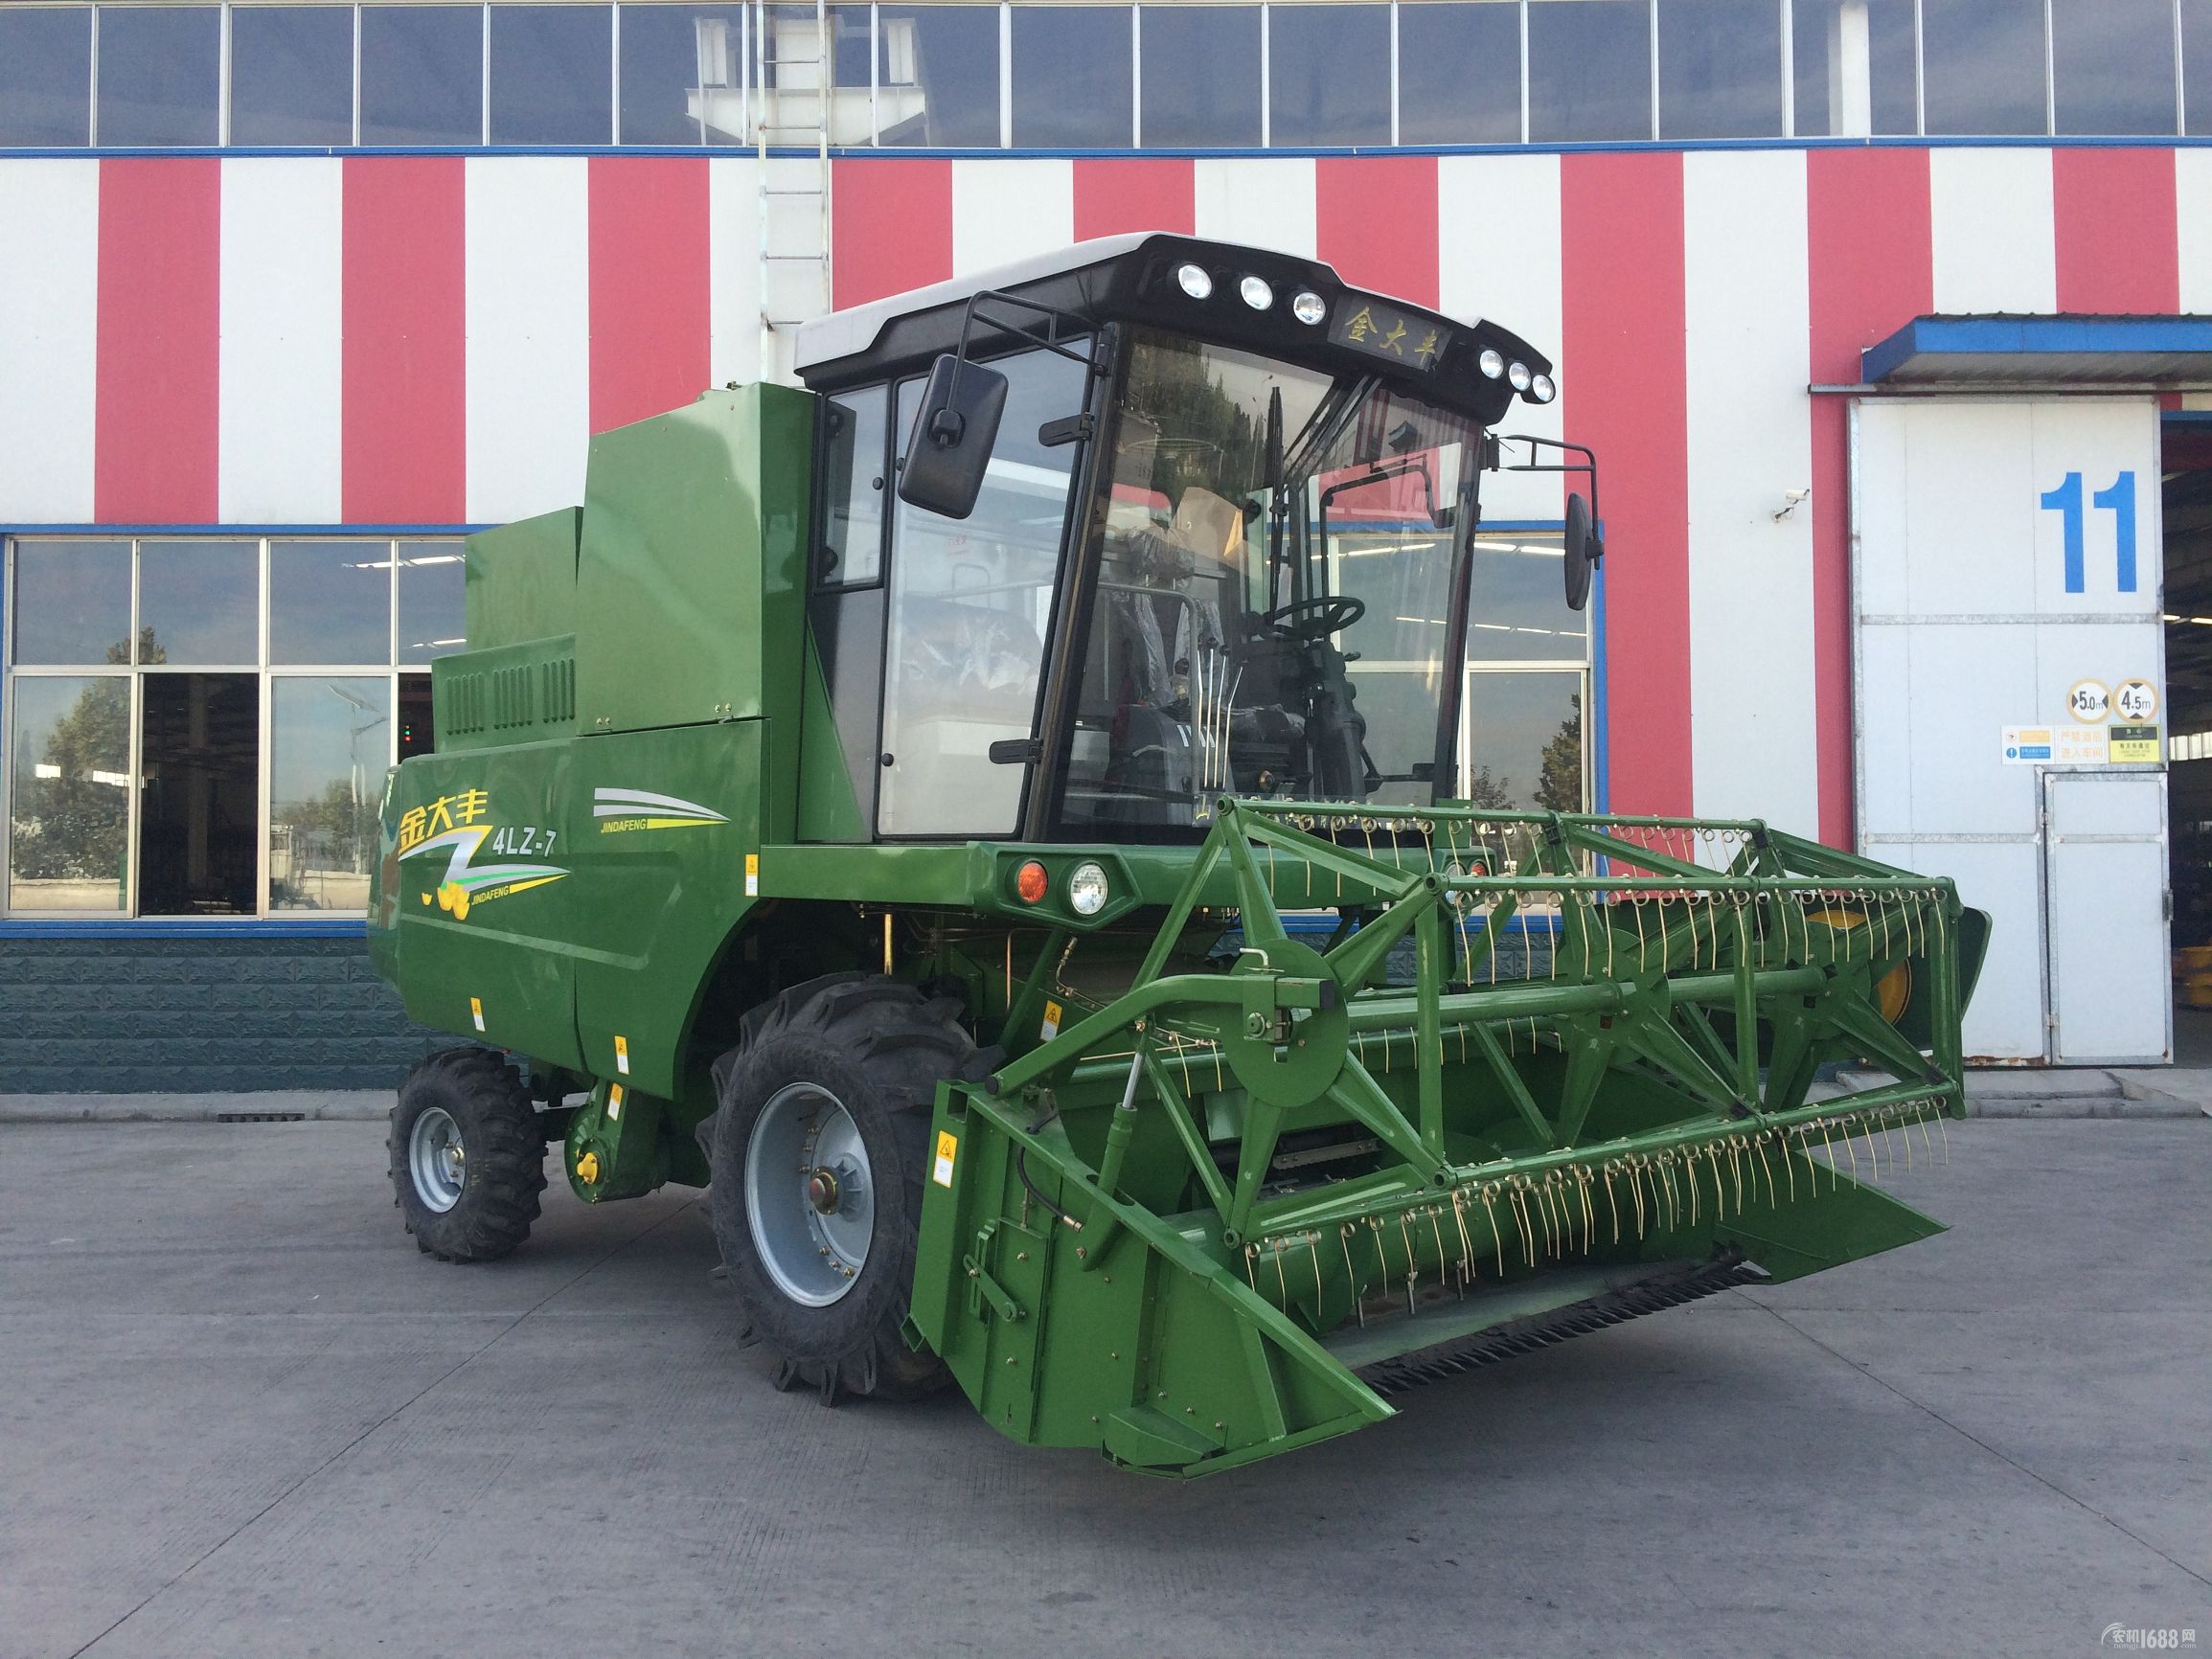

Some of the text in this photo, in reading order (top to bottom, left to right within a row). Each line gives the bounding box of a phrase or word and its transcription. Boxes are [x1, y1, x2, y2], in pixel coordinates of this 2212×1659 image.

[2041, 470, 2137, 594] 11
[2121, 690, 2152, 710] 4.5m
[399, 788, 489, 852] 金大丰
[601, 819, 647, 833] JINDAFENG
[492, 827, 558, 857] 4LZ-7
[470, 885, 510, 905] JINDAFENG
